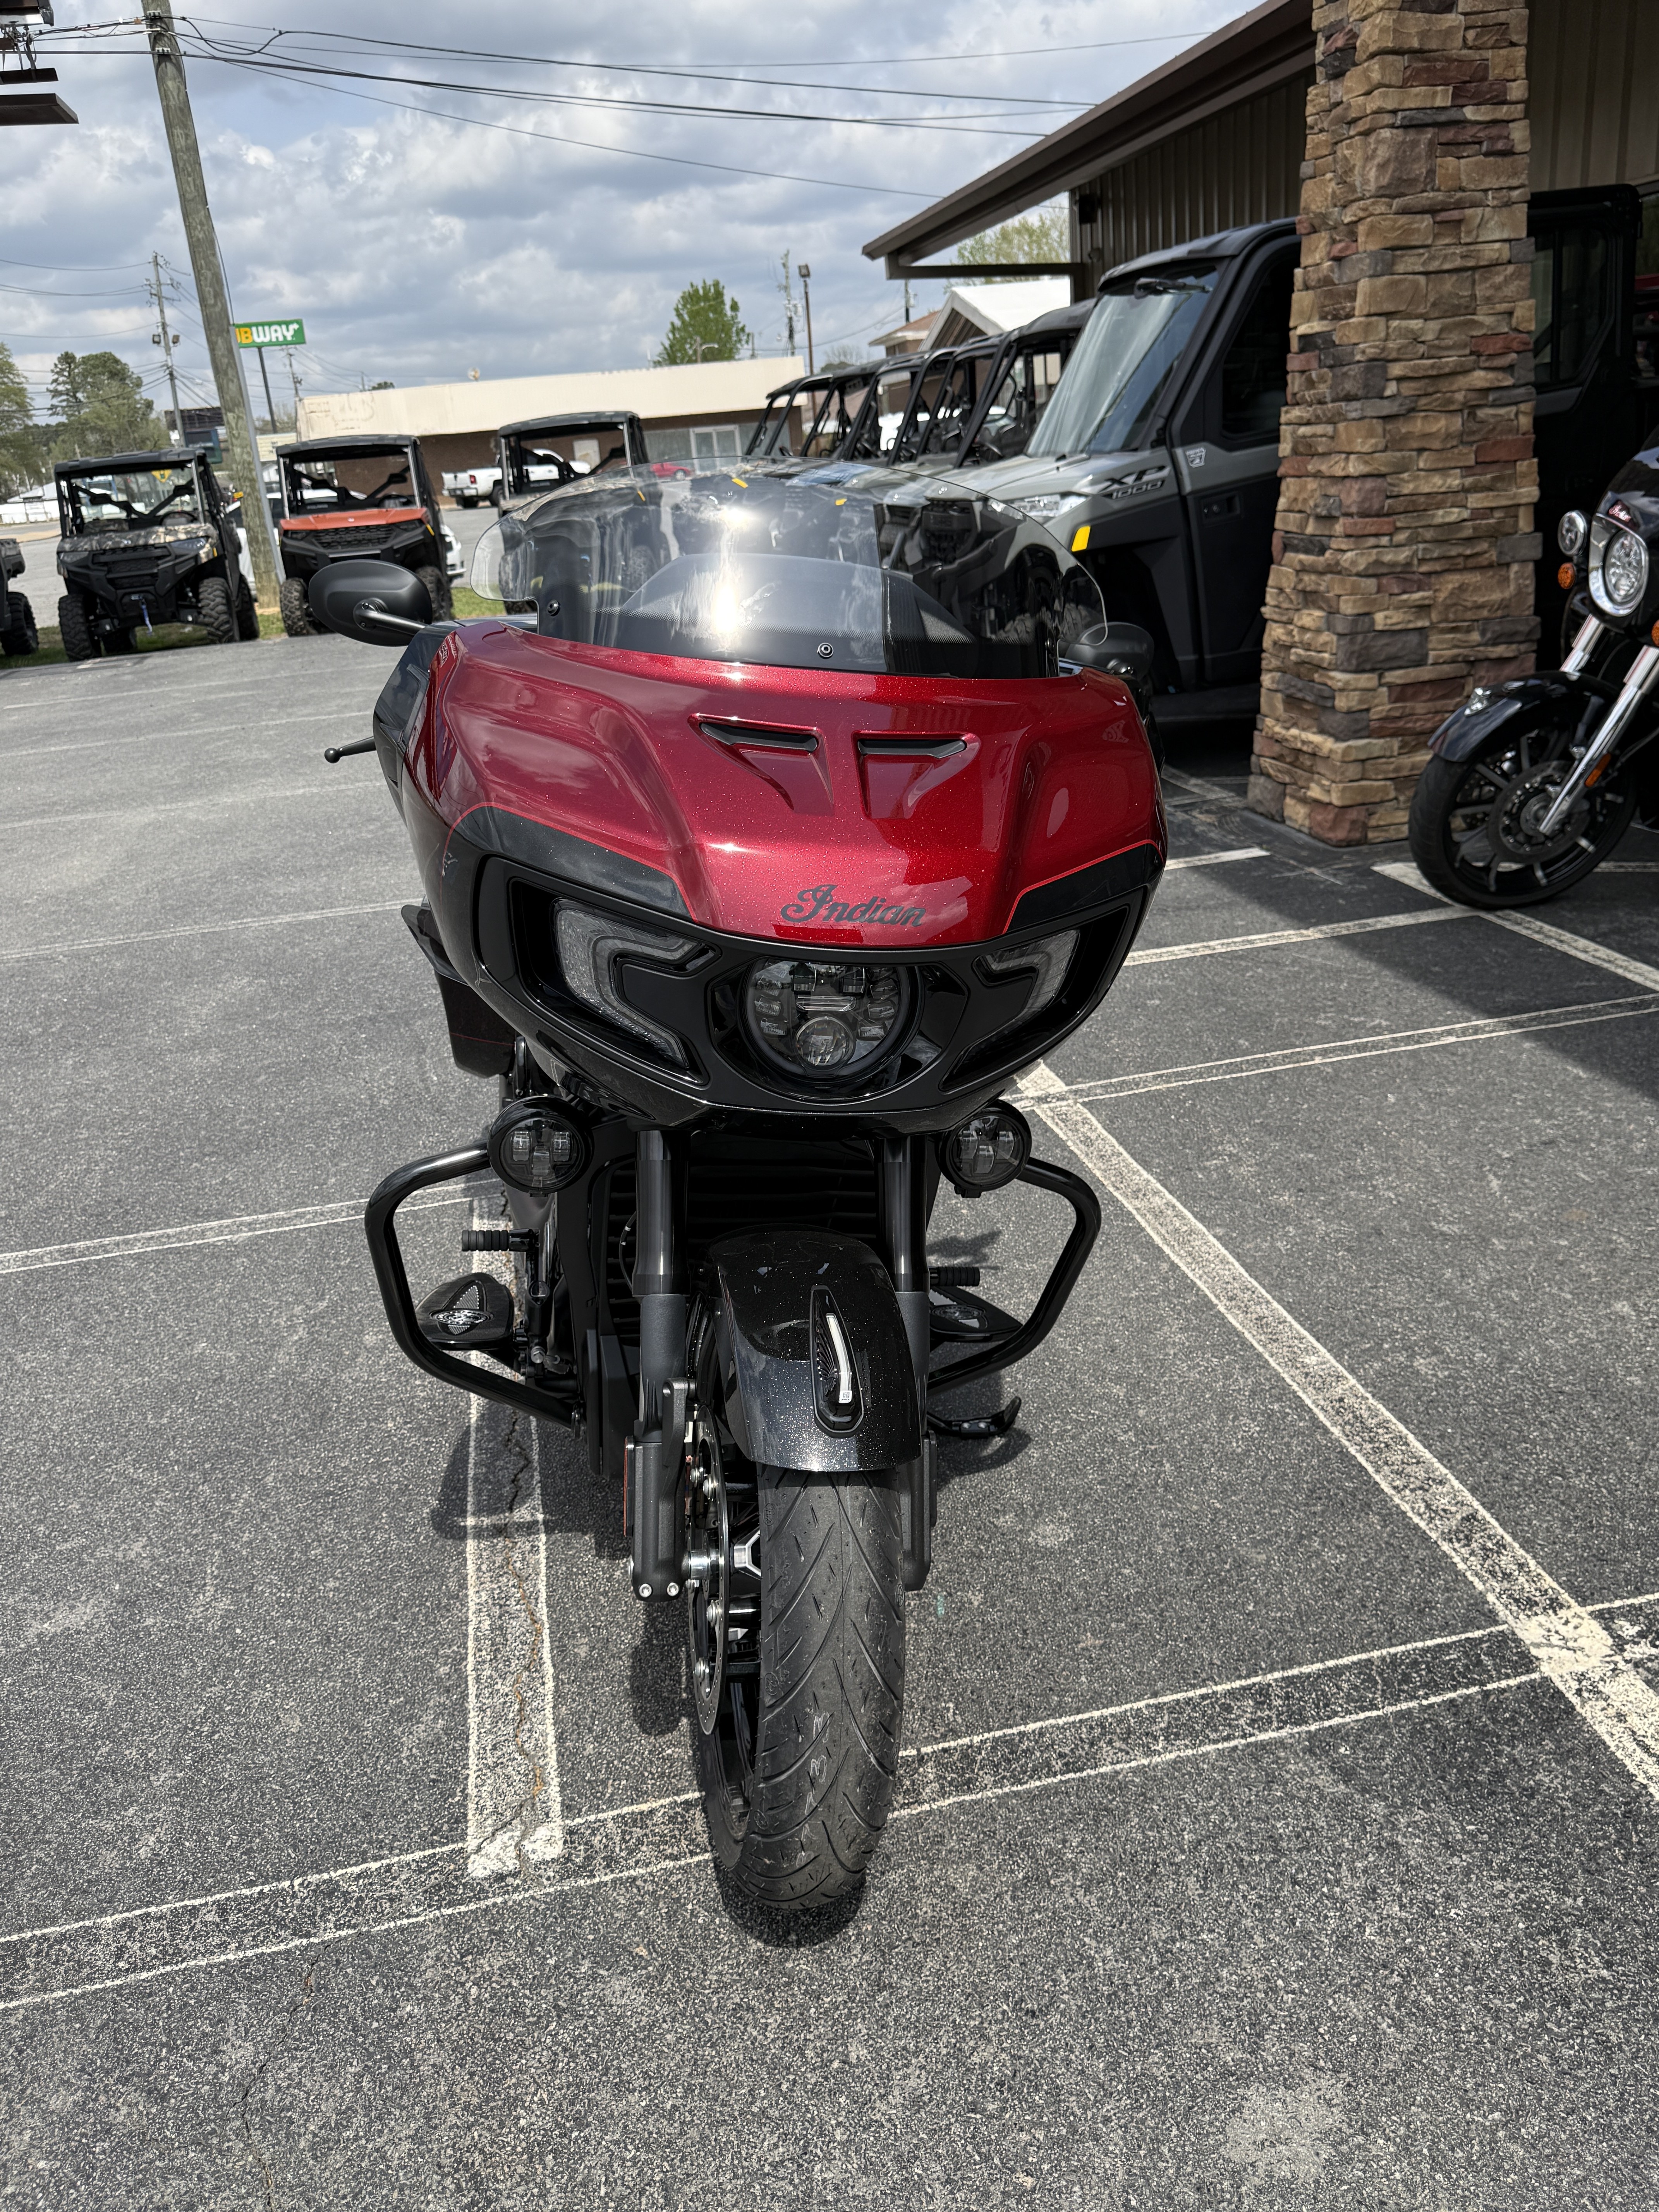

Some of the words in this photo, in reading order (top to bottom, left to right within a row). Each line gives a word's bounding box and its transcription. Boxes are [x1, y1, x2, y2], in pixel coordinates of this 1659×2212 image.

[1098, 465, 1165, 494] XP
[1112, 480, 1162, 499] 1000
[780, 884, 926, 927] Indian
